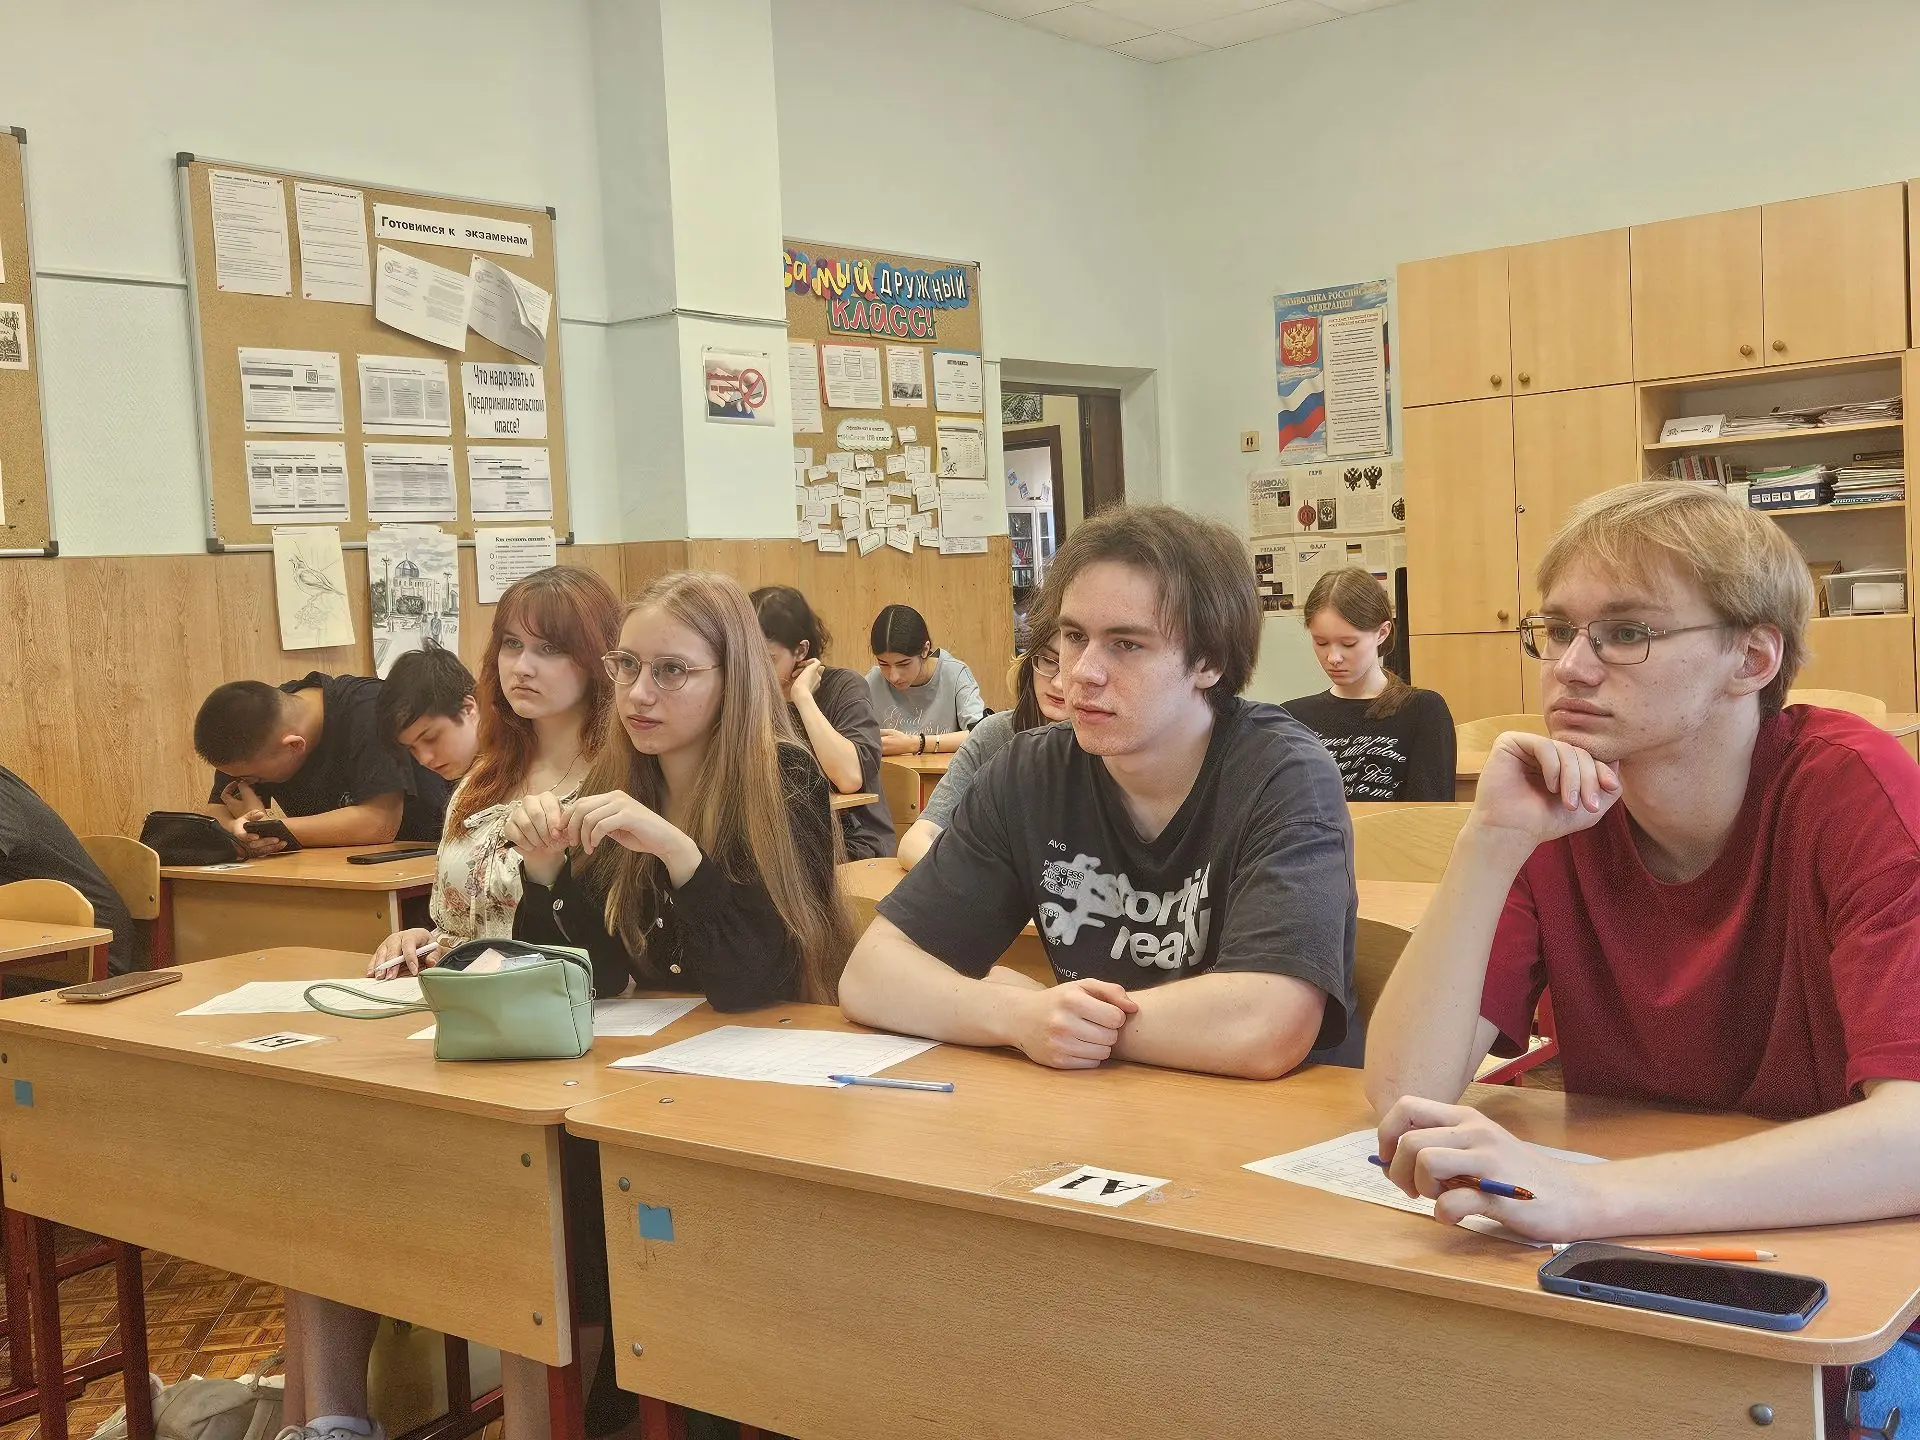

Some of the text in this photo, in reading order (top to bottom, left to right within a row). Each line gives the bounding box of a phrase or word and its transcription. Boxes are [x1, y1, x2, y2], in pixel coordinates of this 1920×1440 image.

[381, 216, 528, 246] Готовимся к экзаменам
[880, 268, 967, 302] ДРУЖНЫЙ
[473, 365, 535, 391] Что надо знать о
[468, 392, 545, 415] Предпринимательском
[494, 417, 520, 433] классе?
[1370, 788, 1393, 798] me
[1047, 839, 1067, 852] AVG
[1041, 869, 1081, 890] AMOUNT
[1043, 859, 1085, 881] PROCESS
